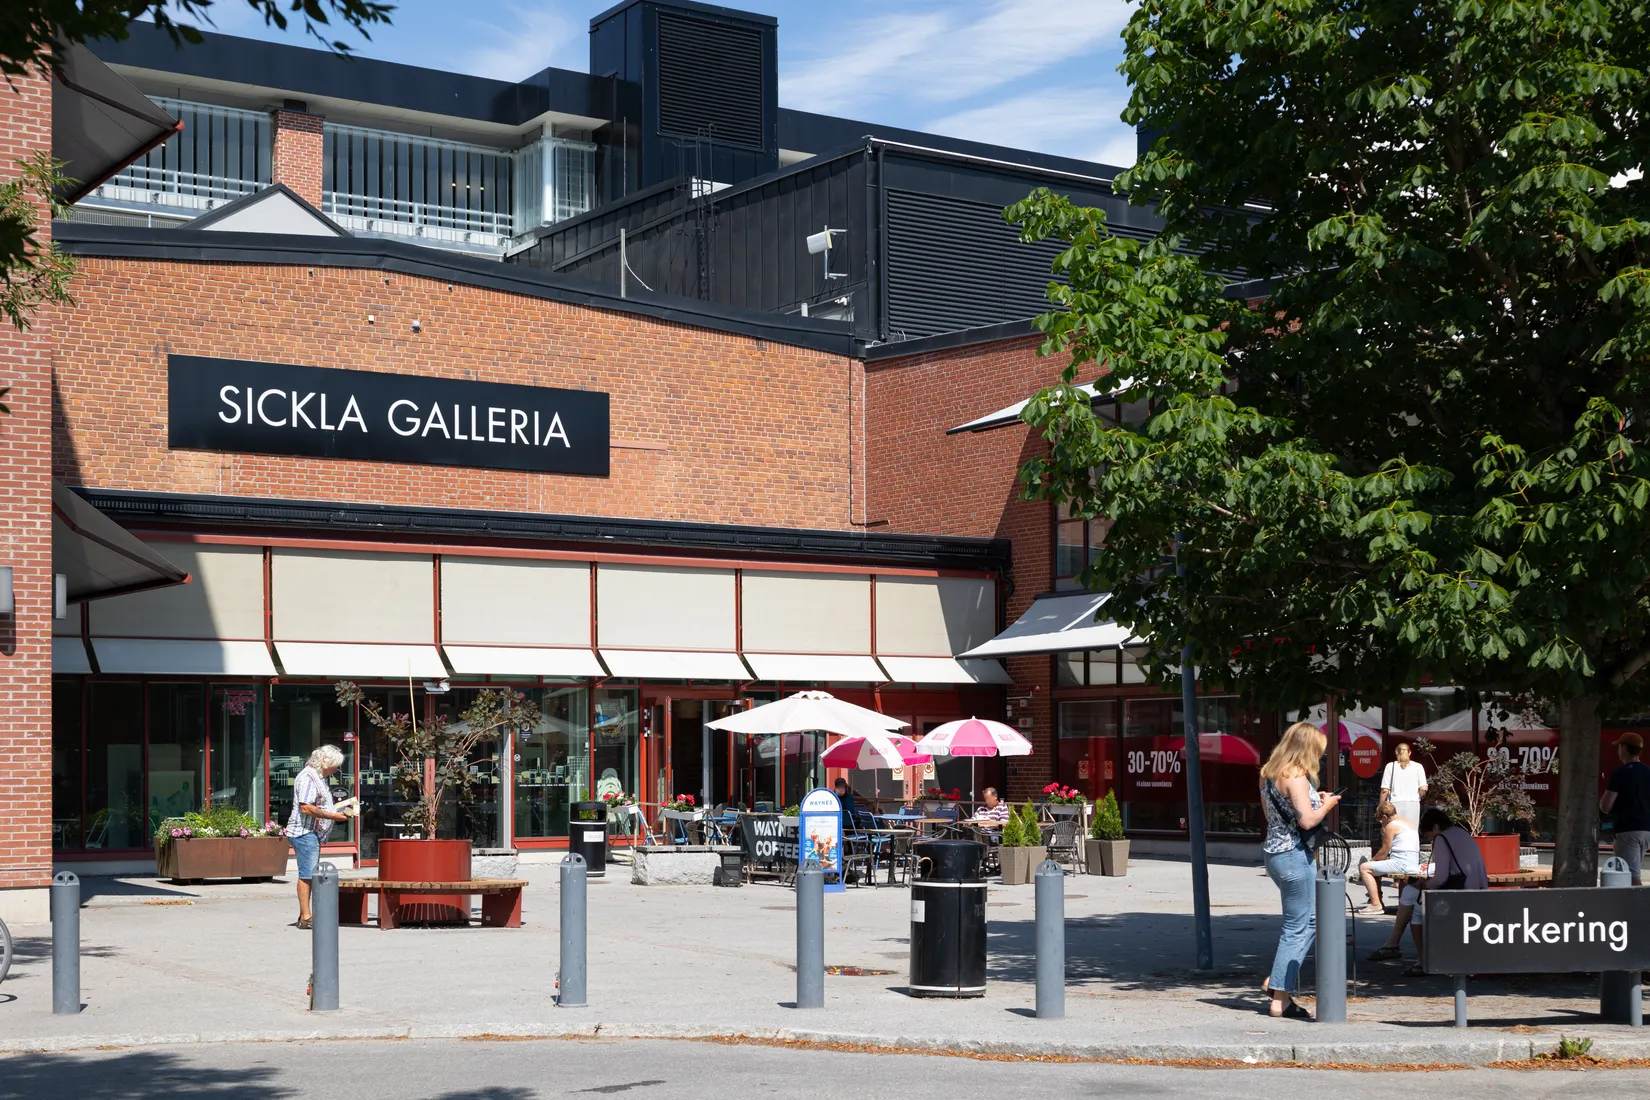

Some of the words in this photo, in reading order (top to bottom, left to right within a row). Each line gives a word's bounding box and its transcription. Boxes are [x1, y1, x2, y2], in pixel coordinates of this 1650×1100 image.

[218, 384, 368, 433] SICKLA
[387, 399, 571, 448] GALLERIA
[1127, 750, 1181, 774] 30-70%
[755, 840, 800, 858] COFFEE
[1462, 907, 1629, 952] Parkering
